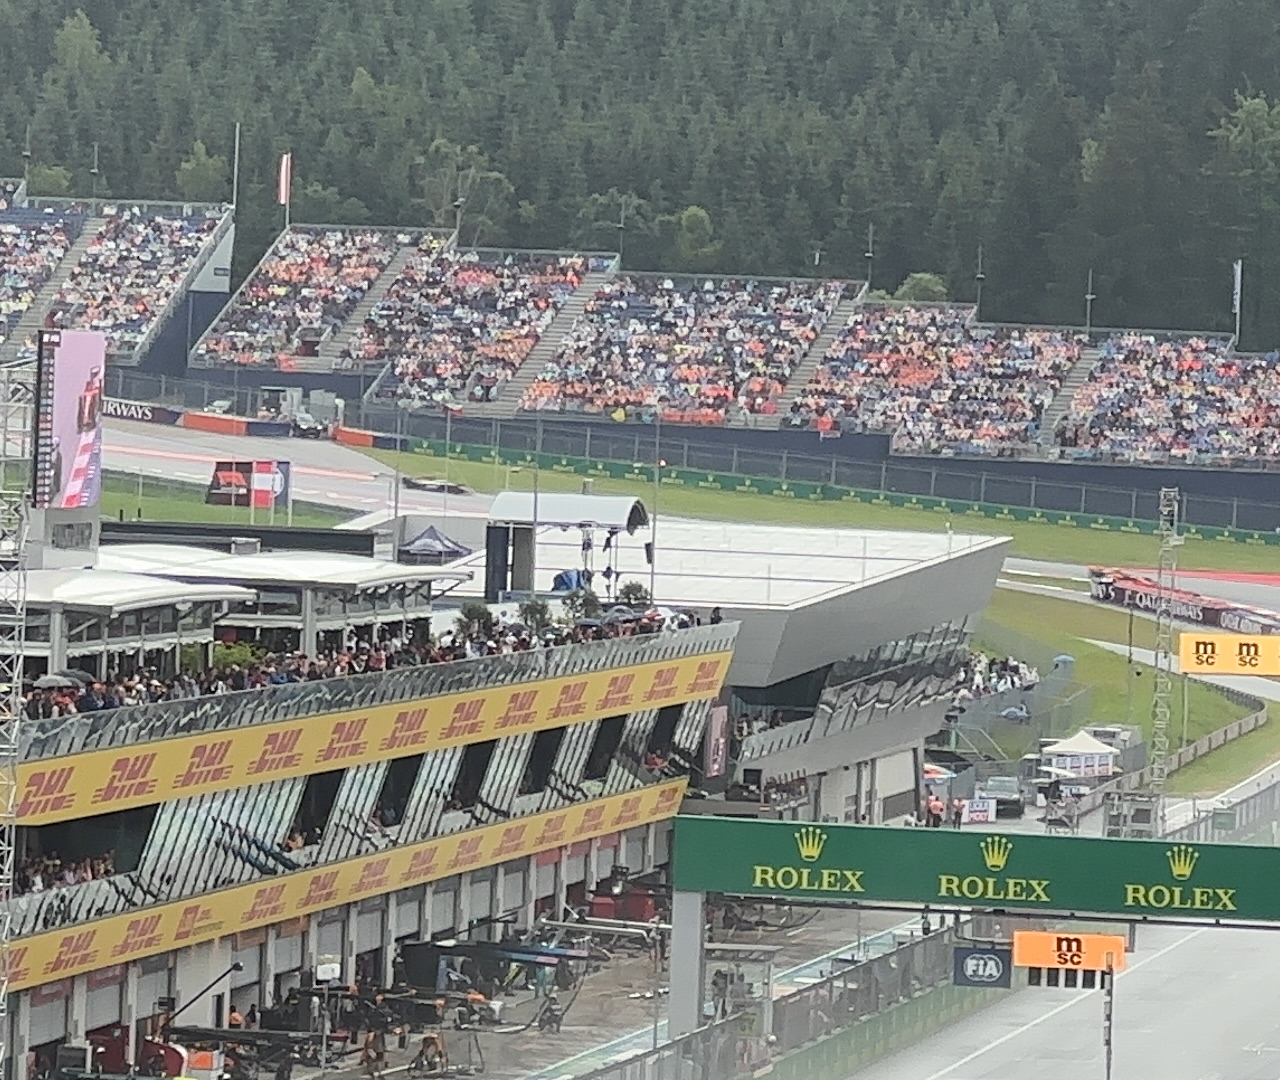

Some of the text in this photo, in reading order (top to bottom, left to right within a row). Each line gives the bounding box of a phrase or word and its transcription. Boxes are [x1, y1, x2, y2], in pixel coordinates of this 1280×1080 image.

[175, 740, 232, 788] DHL
[249, 728, 302, 774] DHL
[93, 753, 157, 803] DHL
[752, 865, 865, 892] ROLEX
[938, 875, 1051, 902] ROLEX
[1124, 884, 1237, 911] ROLEX
